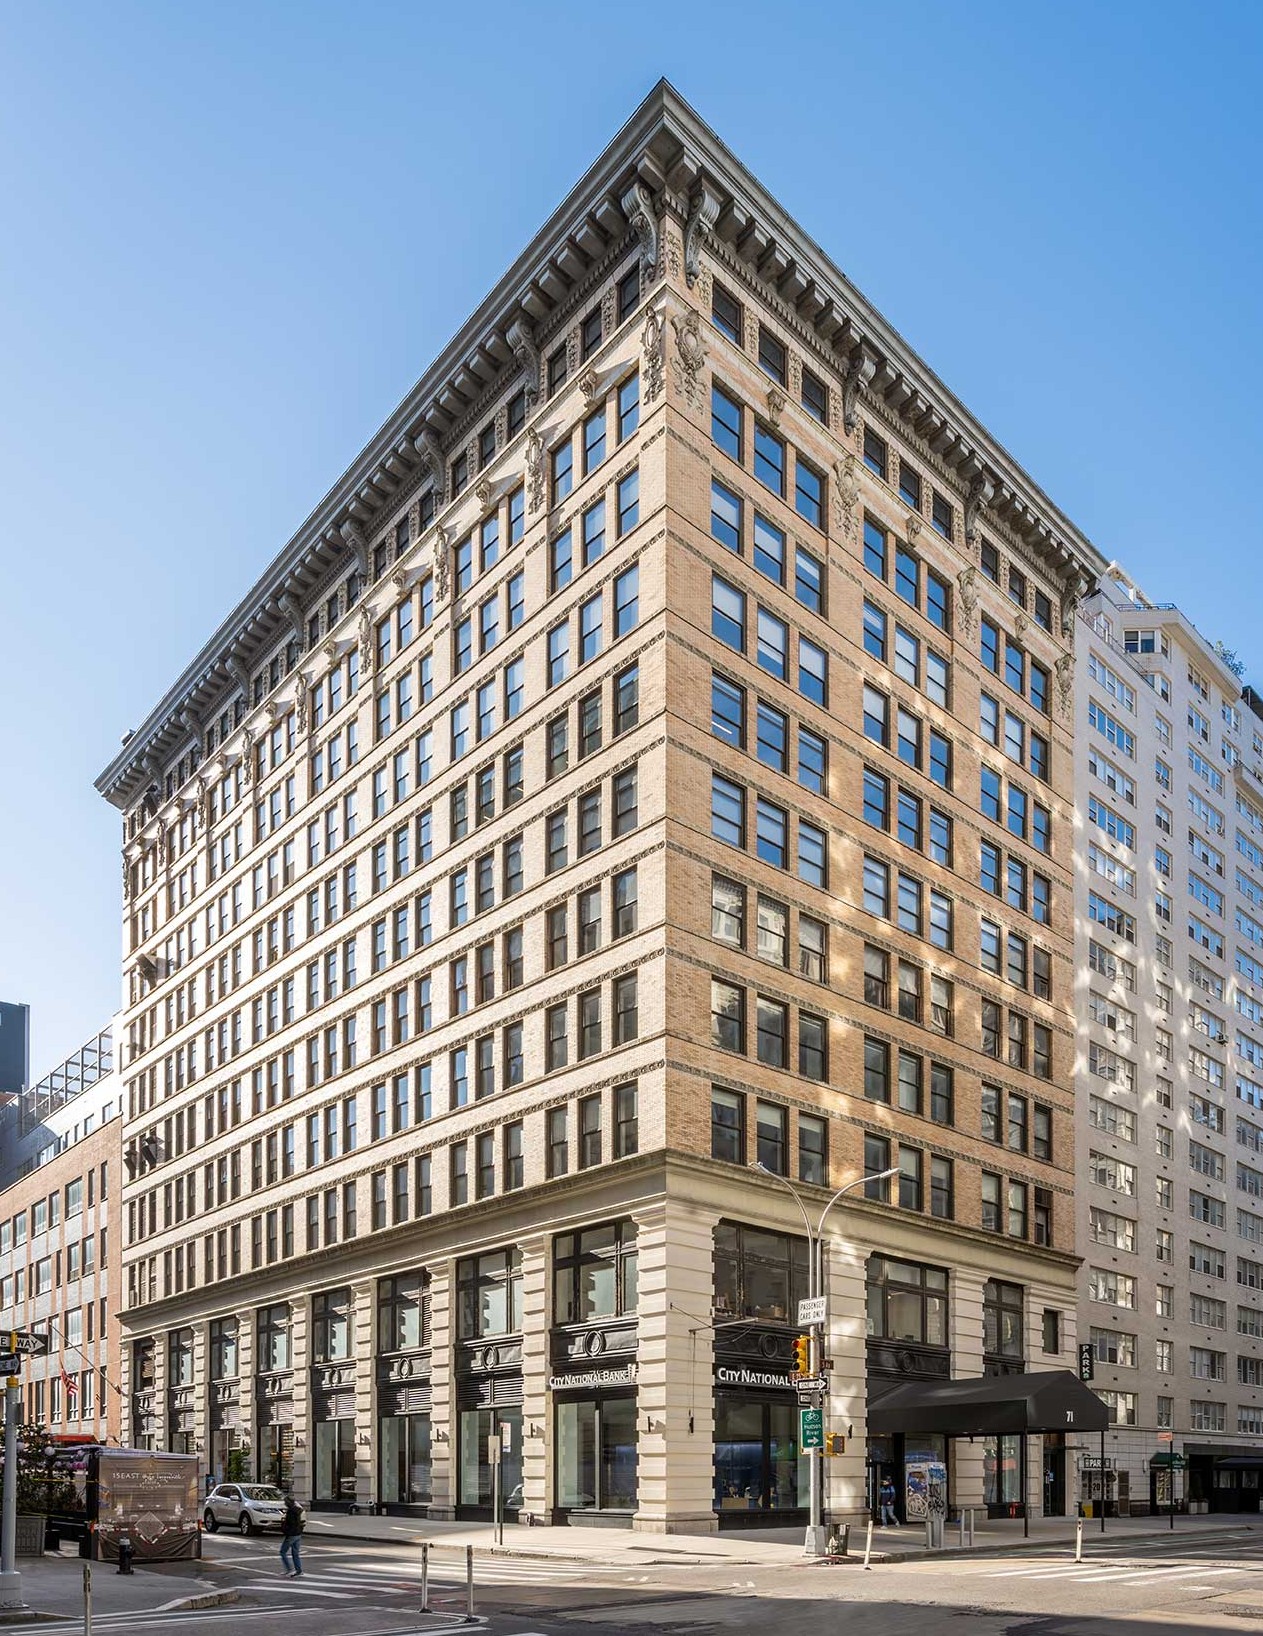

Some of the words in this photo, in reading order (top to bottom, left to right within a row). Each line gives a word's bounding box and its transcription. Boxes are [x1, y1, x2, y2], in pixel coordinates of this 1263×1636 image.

[16, 1338, 38, 1349] WAY
[549, 1375, 565, 1387] CITY
[564, 1372, 603, 1386] NATIONAL
[603, 1370, 627, 1382] BANK
[718, 1367, 740, 1382] CITY
[741, 1369, 791, 1386] NATIONAL
[1066, 1410, 1074, 1422] 71
